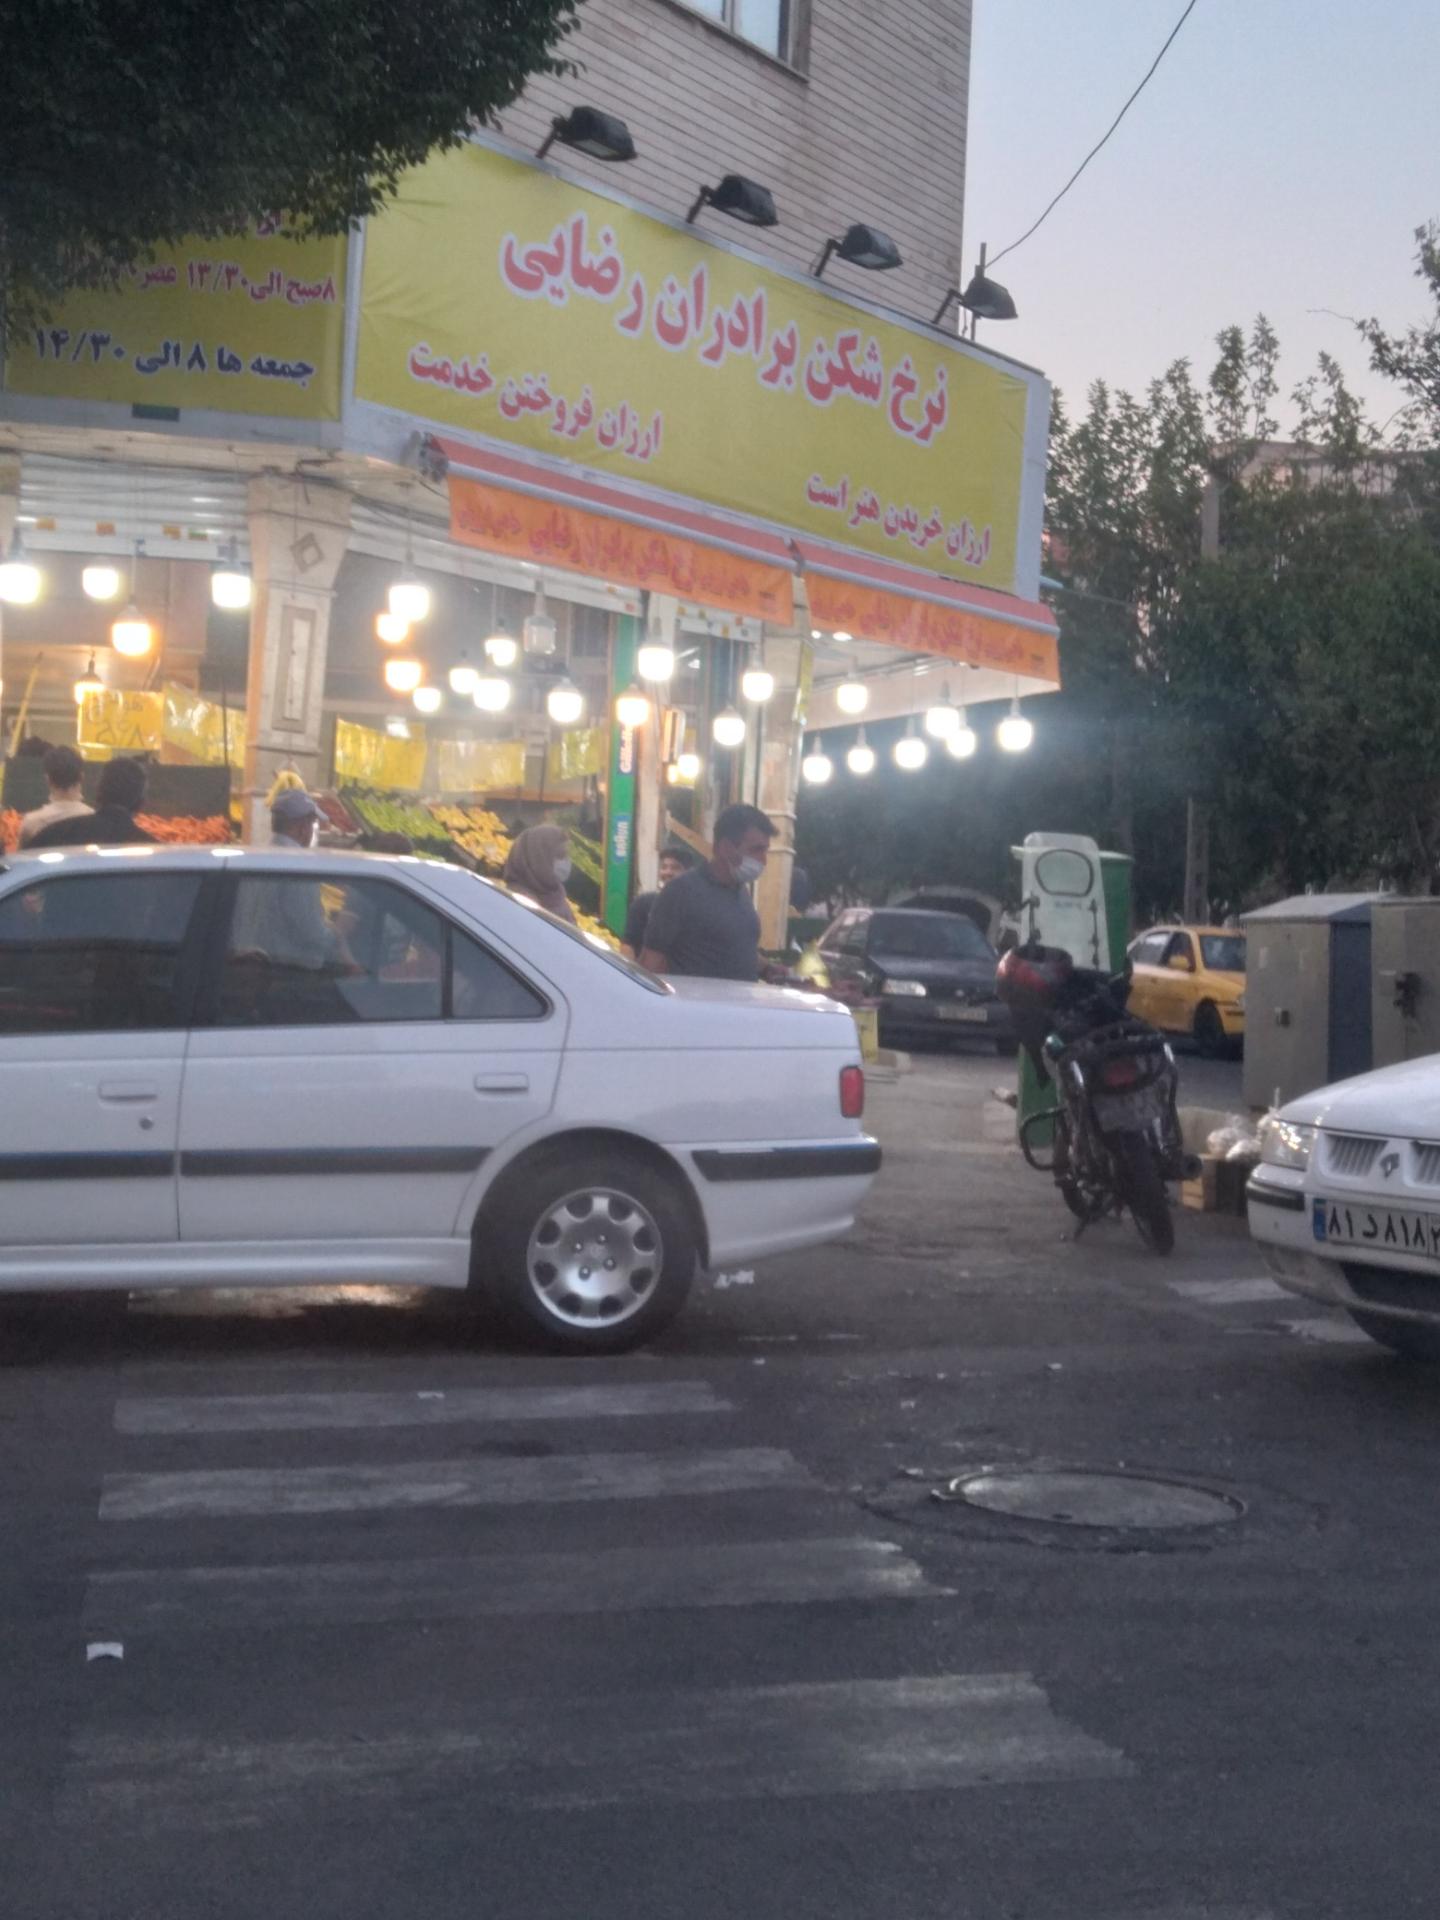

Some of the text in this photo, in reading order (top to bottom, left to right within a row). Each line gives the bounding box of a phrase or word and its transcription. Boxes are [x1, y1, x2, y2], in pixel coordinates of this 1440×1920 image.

[36, 327, 125, 362] ۱۴/۳۰
[216, 346, 242, 374] ها
[502, 214, 947, 443] نرخ شکن برادران رضایی
[250, 356, 314, 387] جمعه
[409, 344, 662, 461] ارزان فروختن خدمت
[806, 474, 991, 566] ارزان خریدن هنر است
